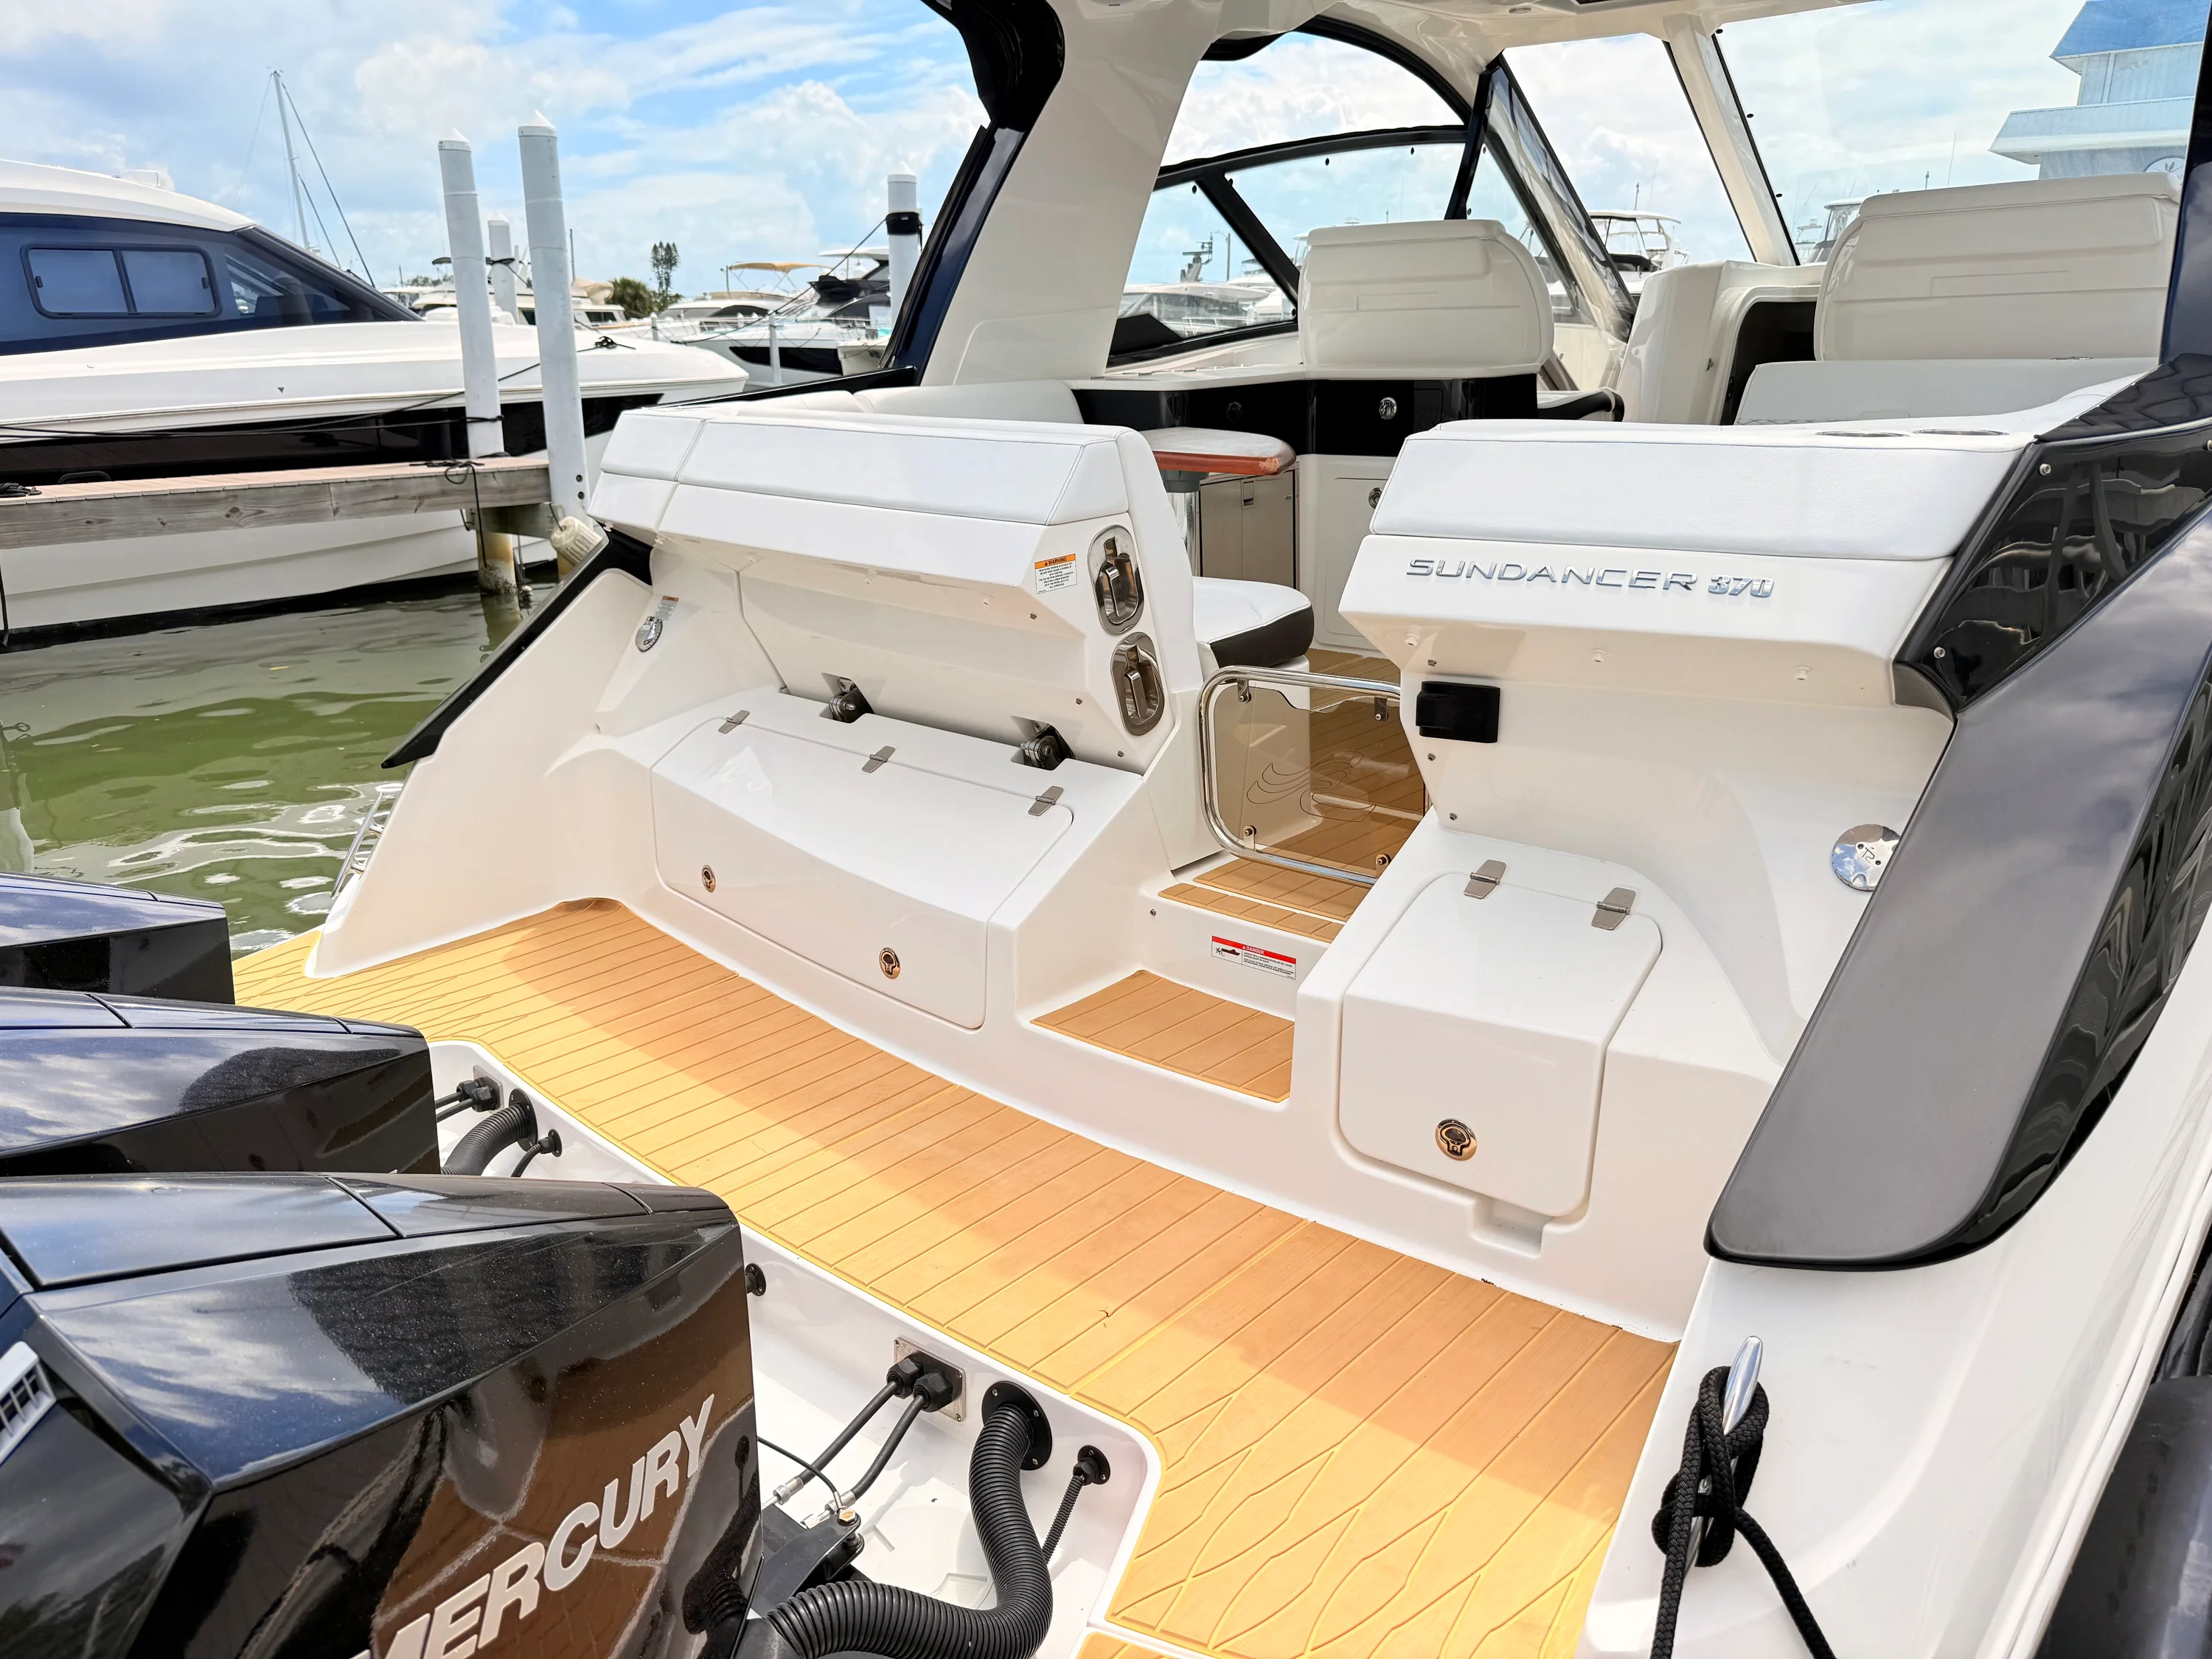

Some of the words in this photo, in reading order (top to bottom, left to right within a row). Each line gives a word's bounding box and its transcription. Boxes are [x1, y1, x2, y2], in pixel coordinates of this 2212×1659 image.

[1048, 557, 1067, 566] WARNING
[1406, 559, 1697, 591] SUNDANCER
[1708, 574, 1774, 598] 370
[1246, 945, 1265, 955] DANGER
